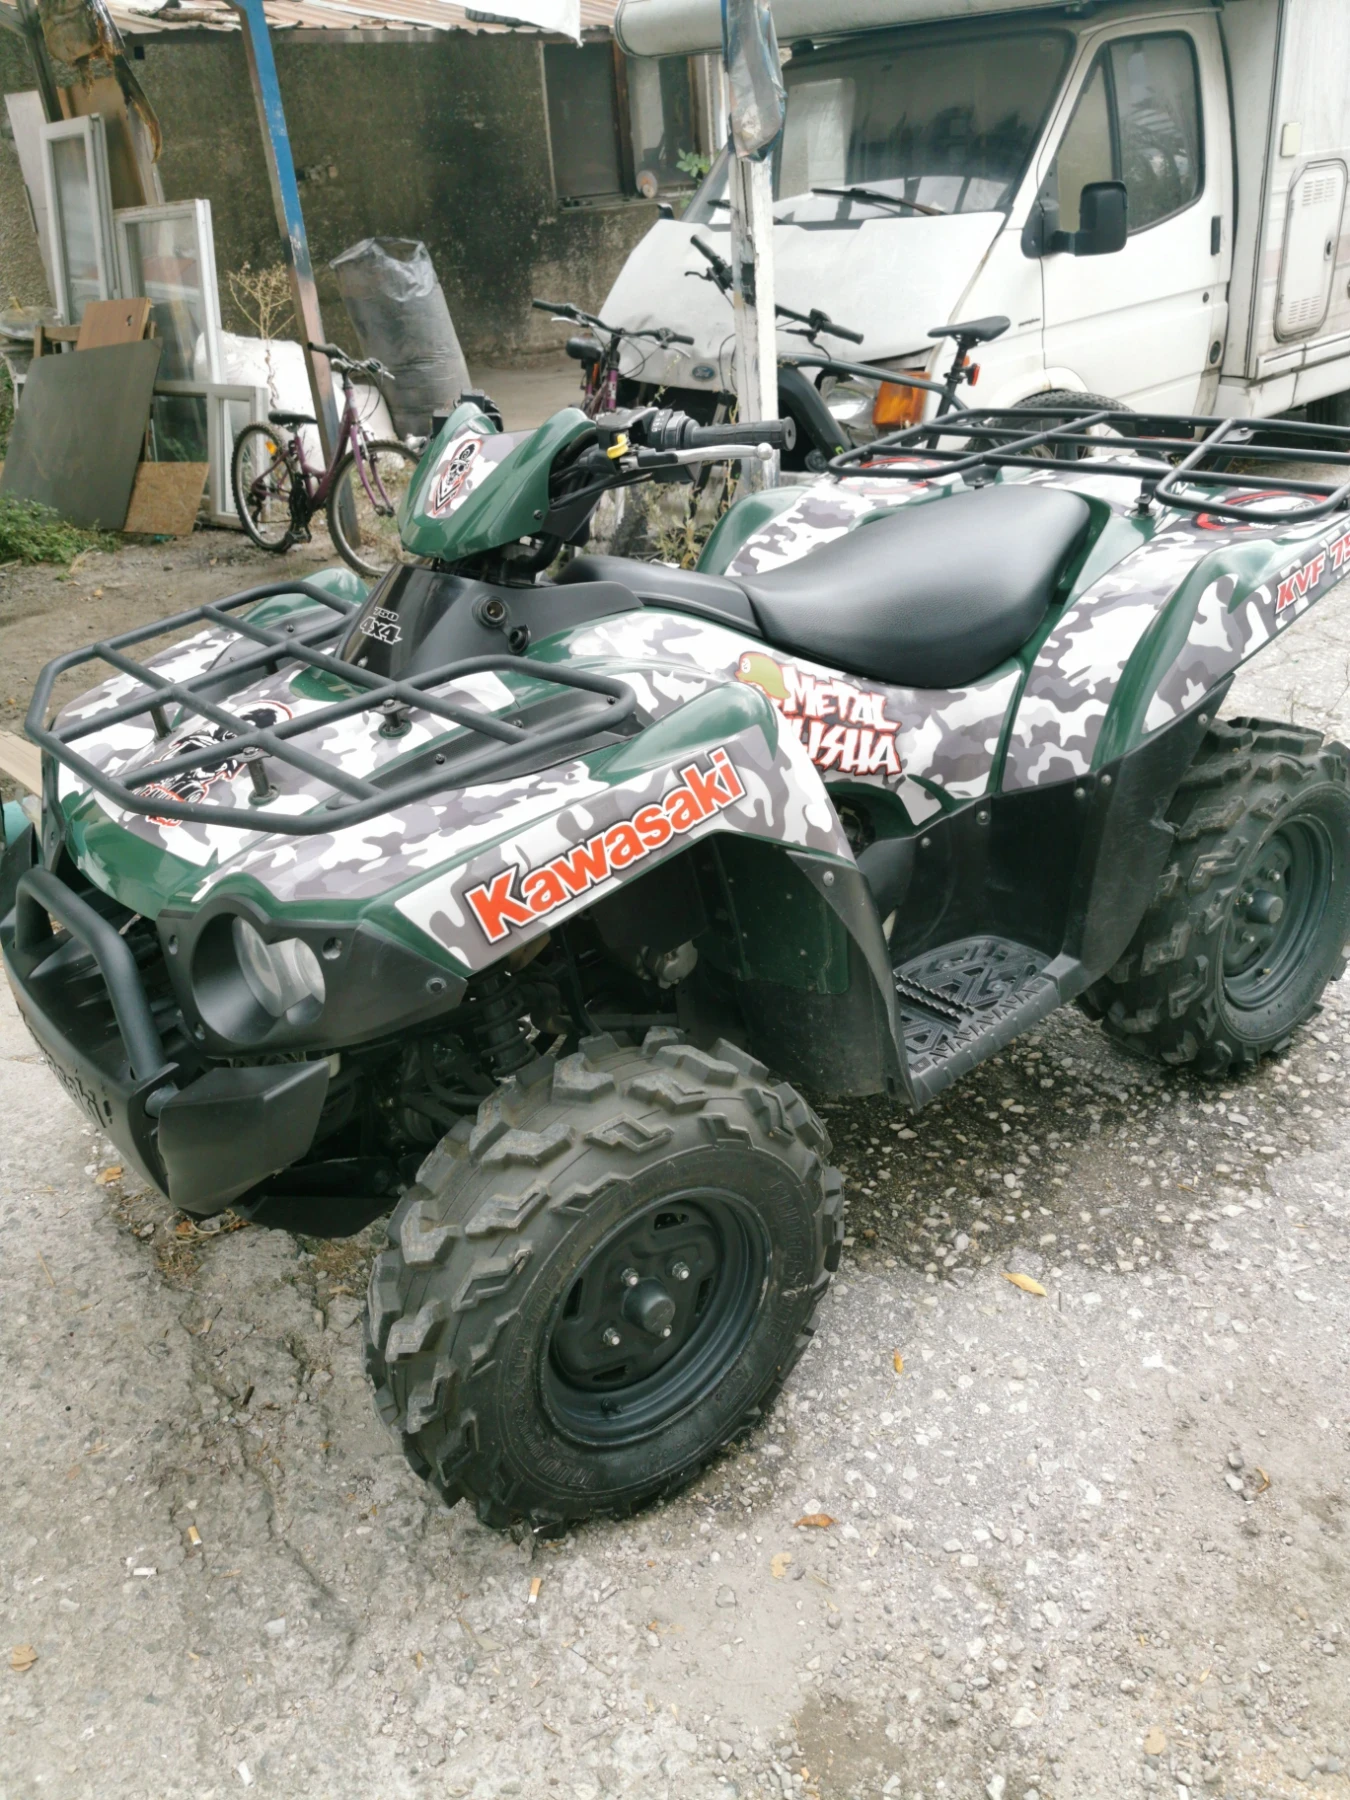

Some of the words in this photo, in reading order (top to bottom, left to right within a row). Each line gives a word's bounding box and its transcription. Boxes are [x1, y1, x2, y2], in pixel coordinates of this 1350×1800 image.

[373, 606, 399, 621] 750
[1276, 550, 1326, 614] KVF
[780, 665, 902, 732] METAL
[465, 747, 746, 943] Kawasaki
